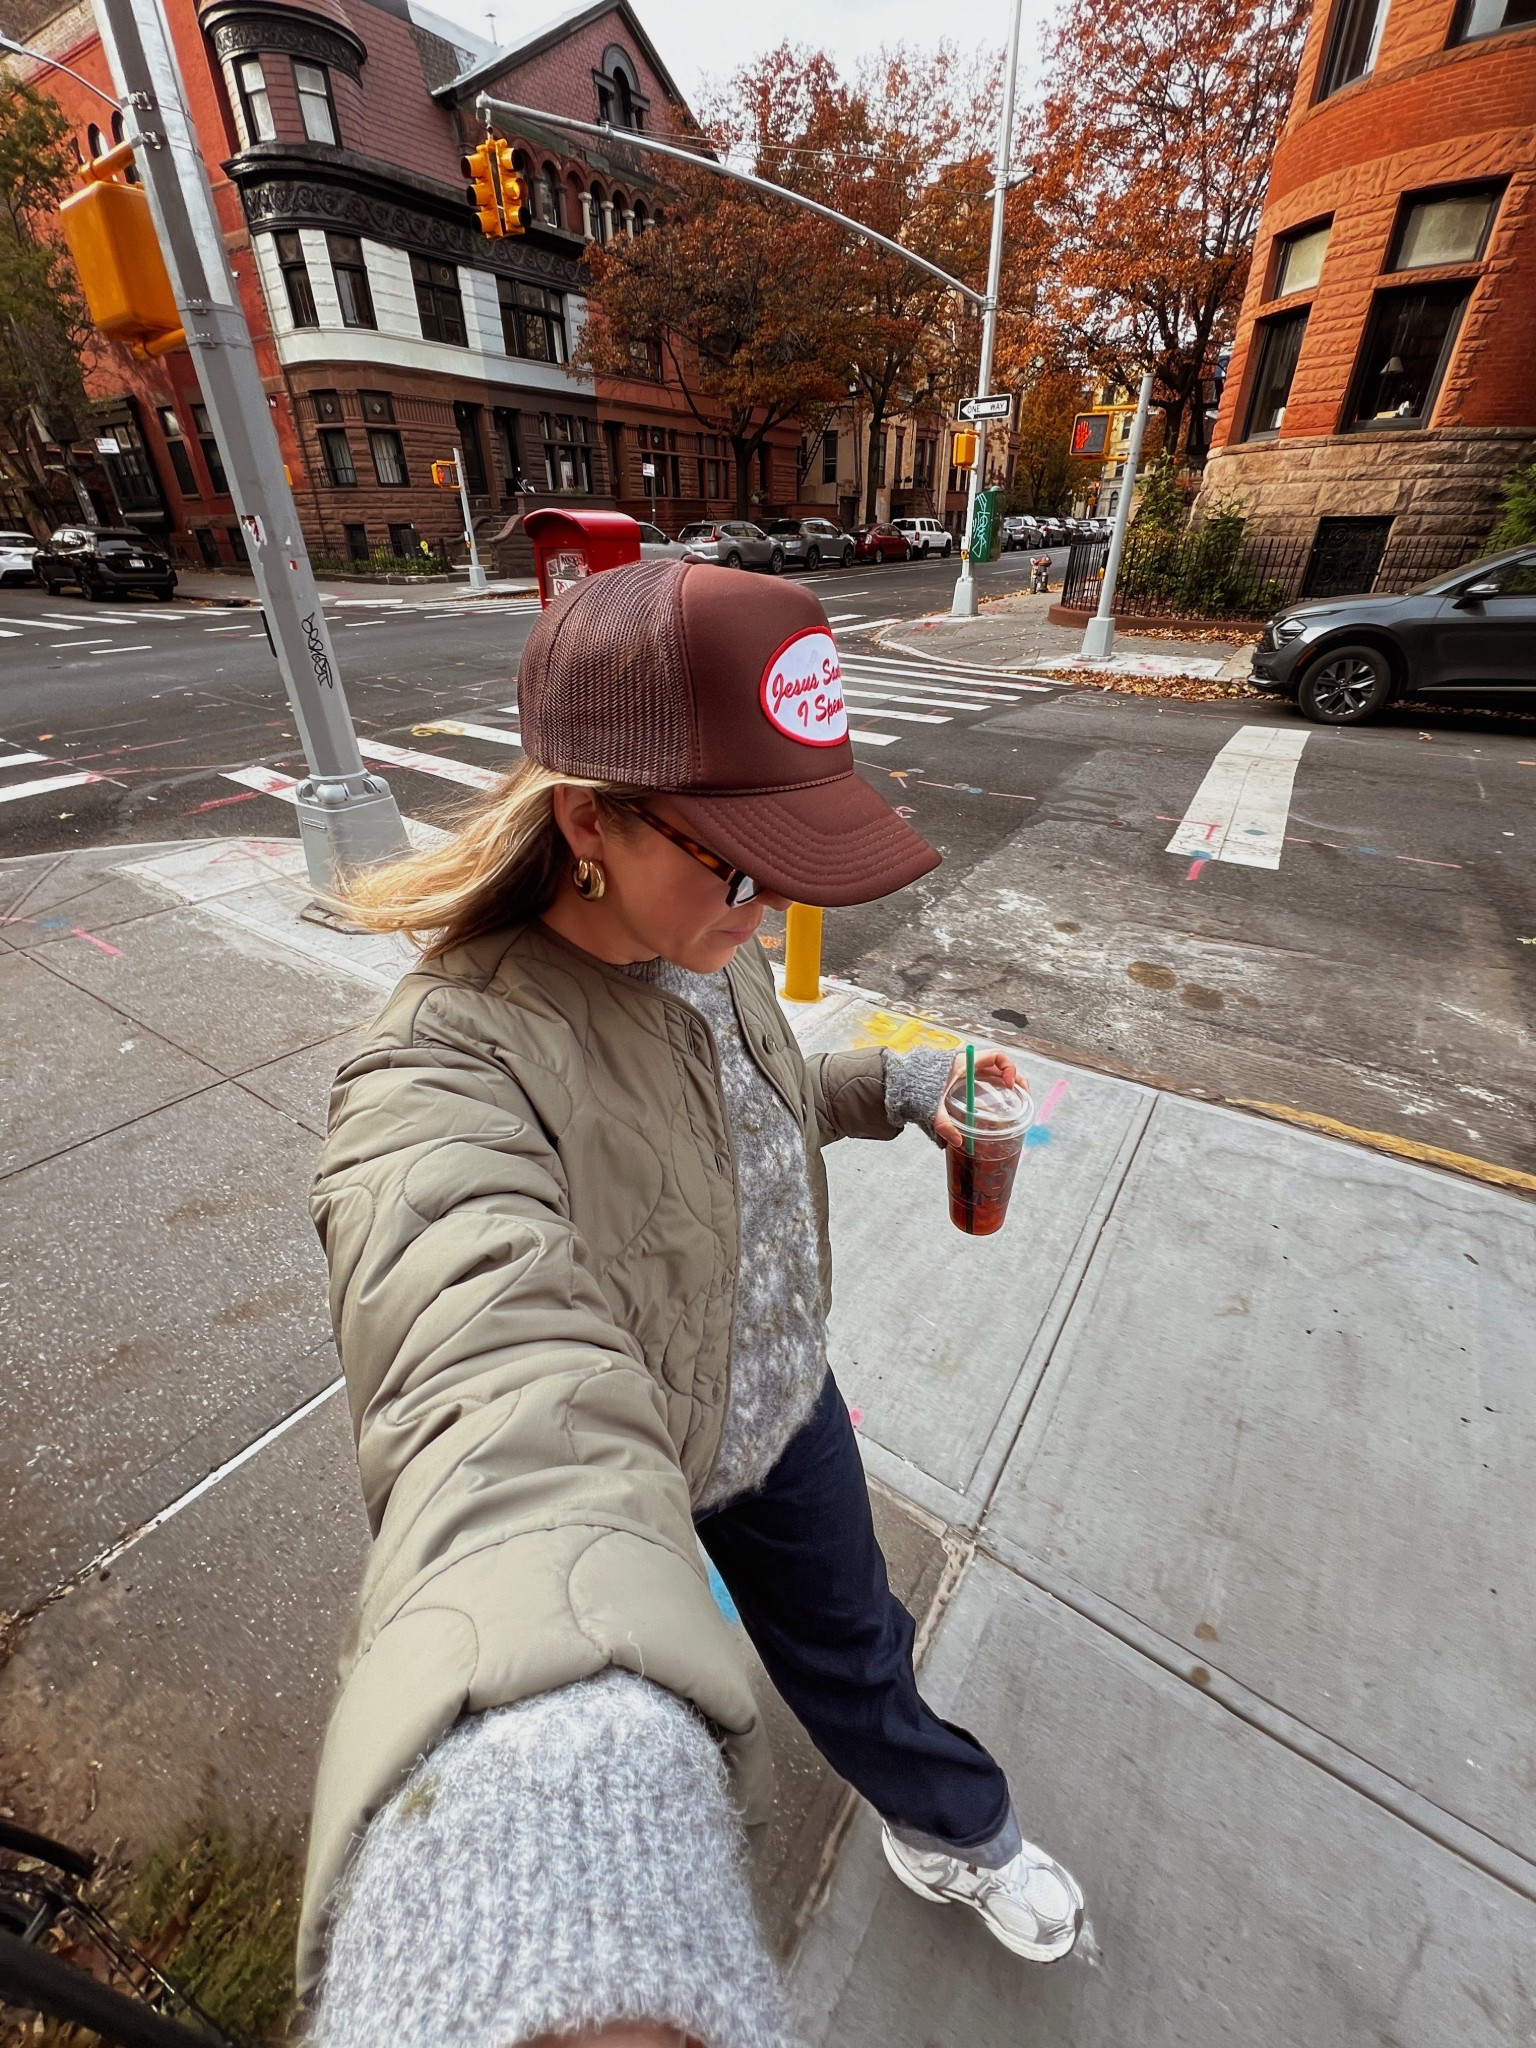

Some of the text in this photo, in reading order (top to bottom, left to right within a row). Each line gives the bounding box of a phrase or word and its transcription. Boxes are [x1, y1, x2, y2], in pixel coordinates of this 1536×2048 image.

[967, 402, 1004, 414] ONE WAY
[772, 673, 819, 714] Jesus
